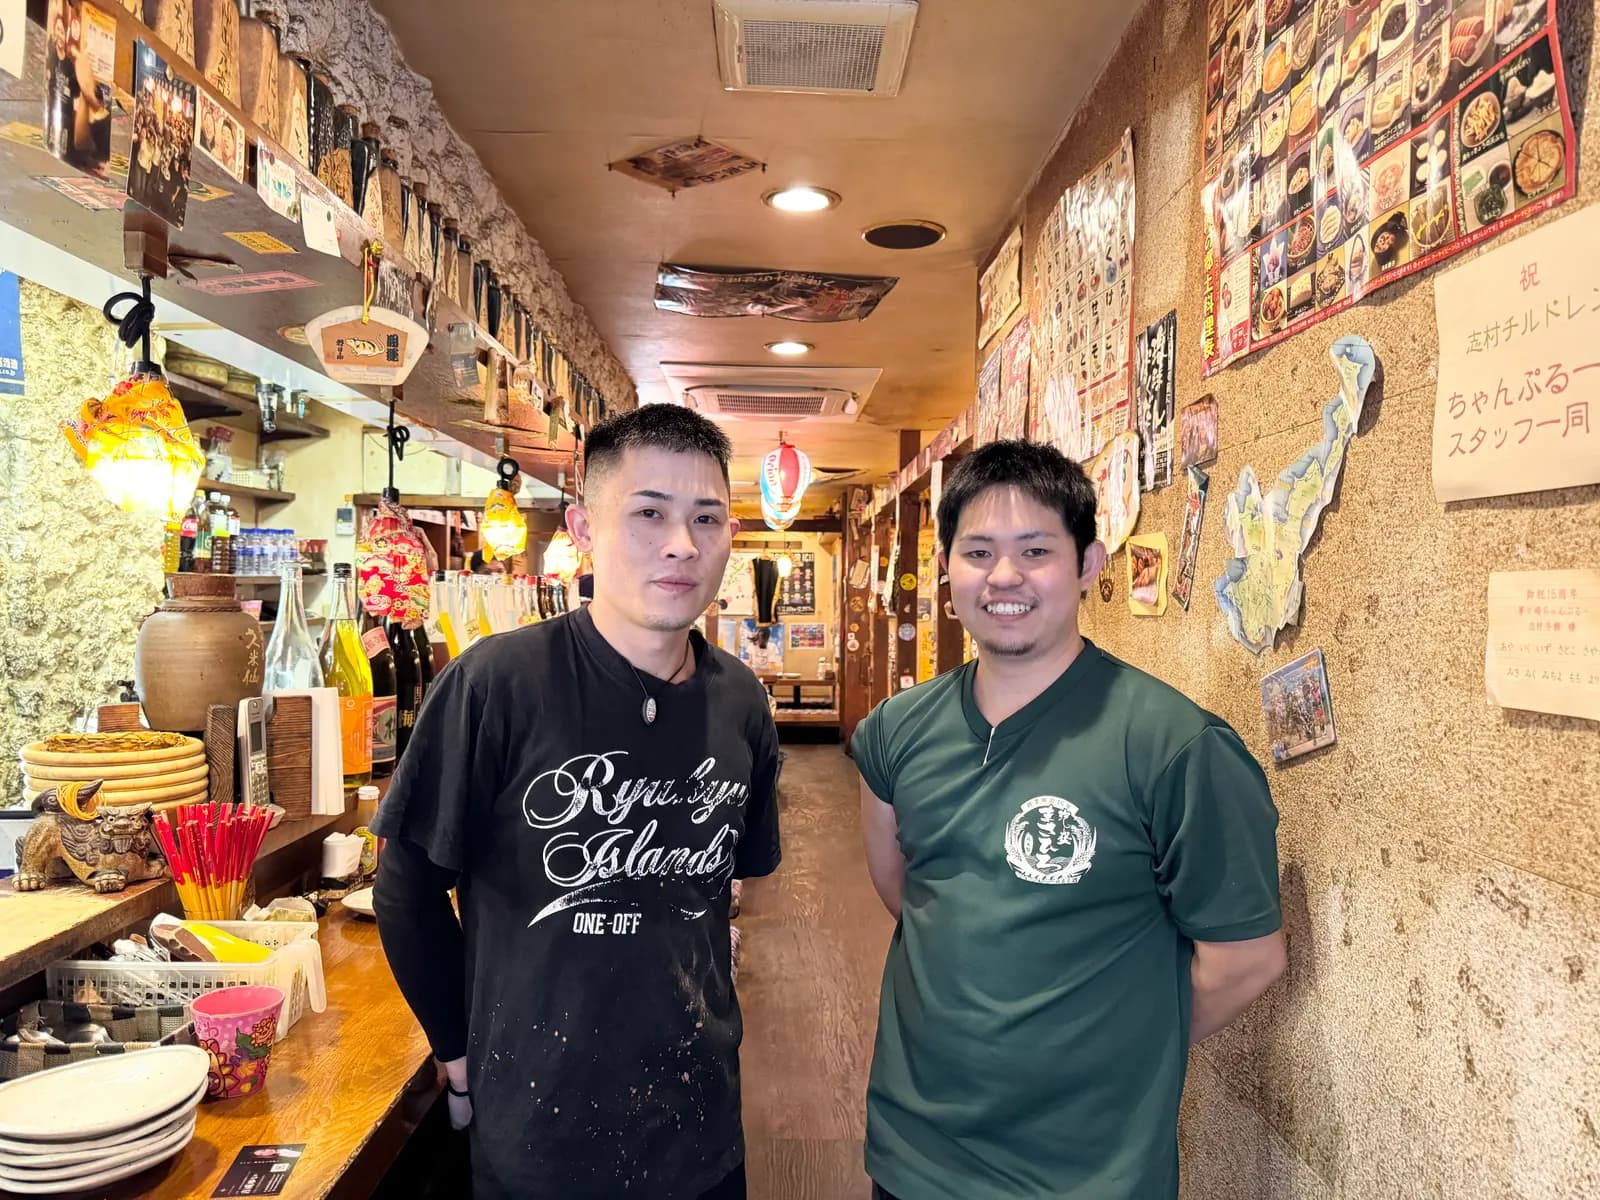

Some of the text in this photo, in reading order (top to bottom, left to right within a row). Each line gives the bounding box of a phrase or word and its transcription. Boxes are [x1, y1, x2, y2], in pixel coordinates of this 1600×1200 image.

[1520, 261, 1541, 292] 祝
[1447, 362, 1600, 420] ちゃんぷるー
[1447, 401, 1590, 458] スタッフ一同
[242, 627, 261, 687] 久米仙
[542, 819, 730, 888] Islands
[573, 912, 642, 936] ONE-OFF
